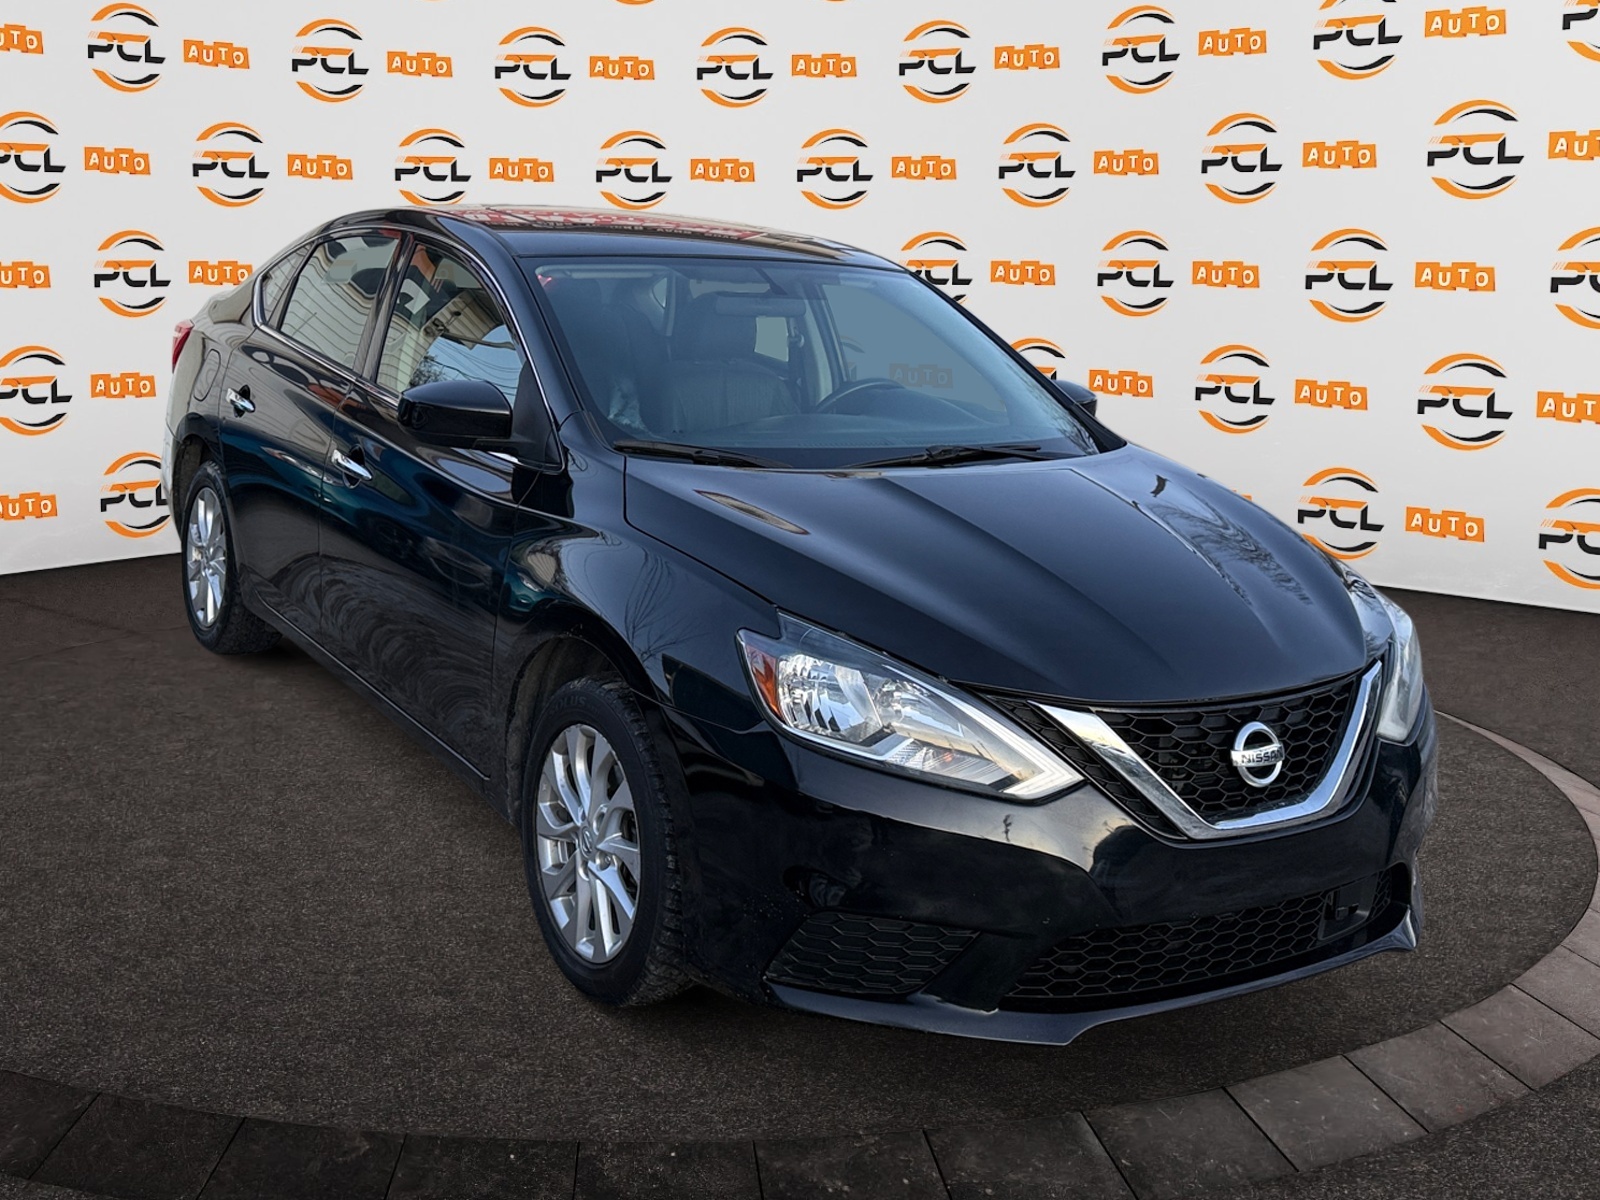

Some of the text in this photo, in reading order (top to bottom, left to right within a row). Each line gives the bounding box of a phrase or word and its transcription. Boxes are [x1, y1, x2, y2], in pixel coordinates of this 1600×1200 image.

[0, 30, 40, 51] TO
[1314, 13, 1502, 49] PCL AUTO
[87, 32, 246, 67] PCL AUTO
[292, 47, 449, 76] PCL AUTO
[899, 48, 1057, 75] PCL AUTO
[1103, 34, 1263, 66] PCL AUTO
[495, 54, 651, 80] PCL AUTO
[697, 55, 854, 80] PCL AUTO
[89, 152, 147, 173] AUTO
[1202, 144, 1373, 173] PCL AUTO
[1427, 133, 1524, 166] PCL
[193, 151, 350, 178] PCL AUTO
[395, 156, 551, 181] PCL AUTO
[596, 158, 752, 182] PCL AUTO
[797, 157, 953, 182] PCL AUTO
[999, 152, 1156, 179] PCL AUTO
[0, 267, 47, 287] UTO
[95, 260, 250, 287] PCL AUTO
[995, 265, 1052, 284] AUTO
[1098, 260, 1256, 287] PCL AUTO
[1306, 261, 1491, 290] PCL AUTO
[0, 376, 152, 404] PCL AUTO
[1093, 375, 1150, 395] AUTO
[1195, 374, 1364, 408] PCL AUTO
[1418, 386, 1598, 420] PCL AUT
[0, 498, 54, 519] UTO
[101, 480, 168, 512] PCL
[1298, 497, 1480, 539] PCL AUTO
[1539, 520, 1600, 555] PC
